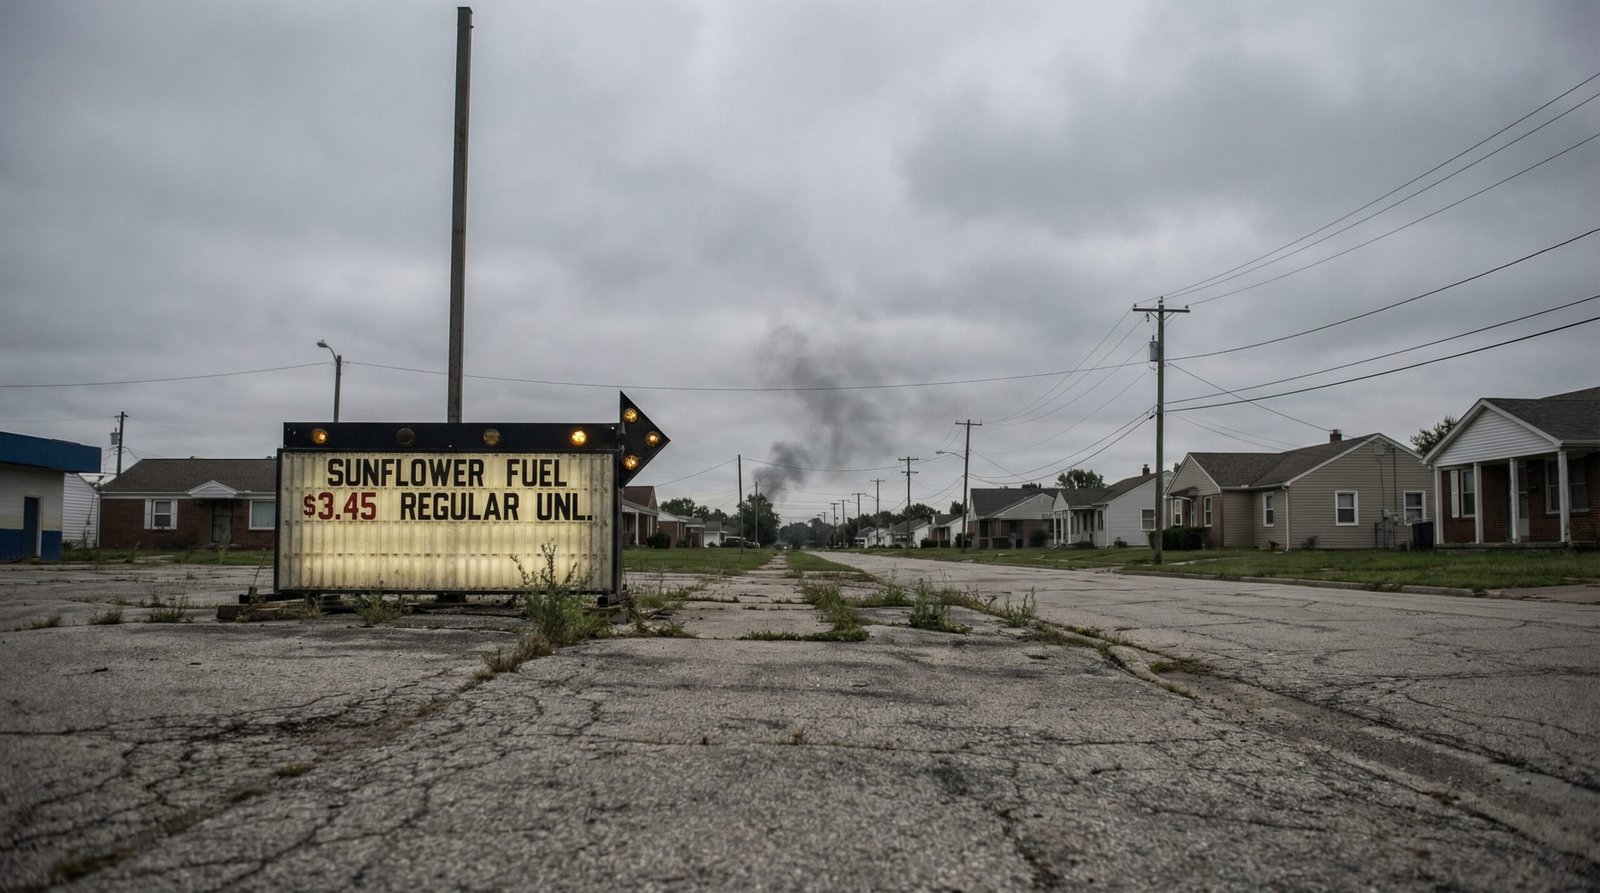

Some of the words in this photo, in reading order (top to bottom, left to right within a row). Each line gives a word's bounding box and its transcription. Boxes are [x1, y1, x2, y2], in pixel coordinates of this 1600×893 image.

[327, 458, 484, 487] SUNFLOWER
[507, 458, 567, 487] FUEL
[303, 491, 377, 520] $3.45
[400, 492, 520, 521] REGULAR
[536, 492, 593, 521] UNL.
